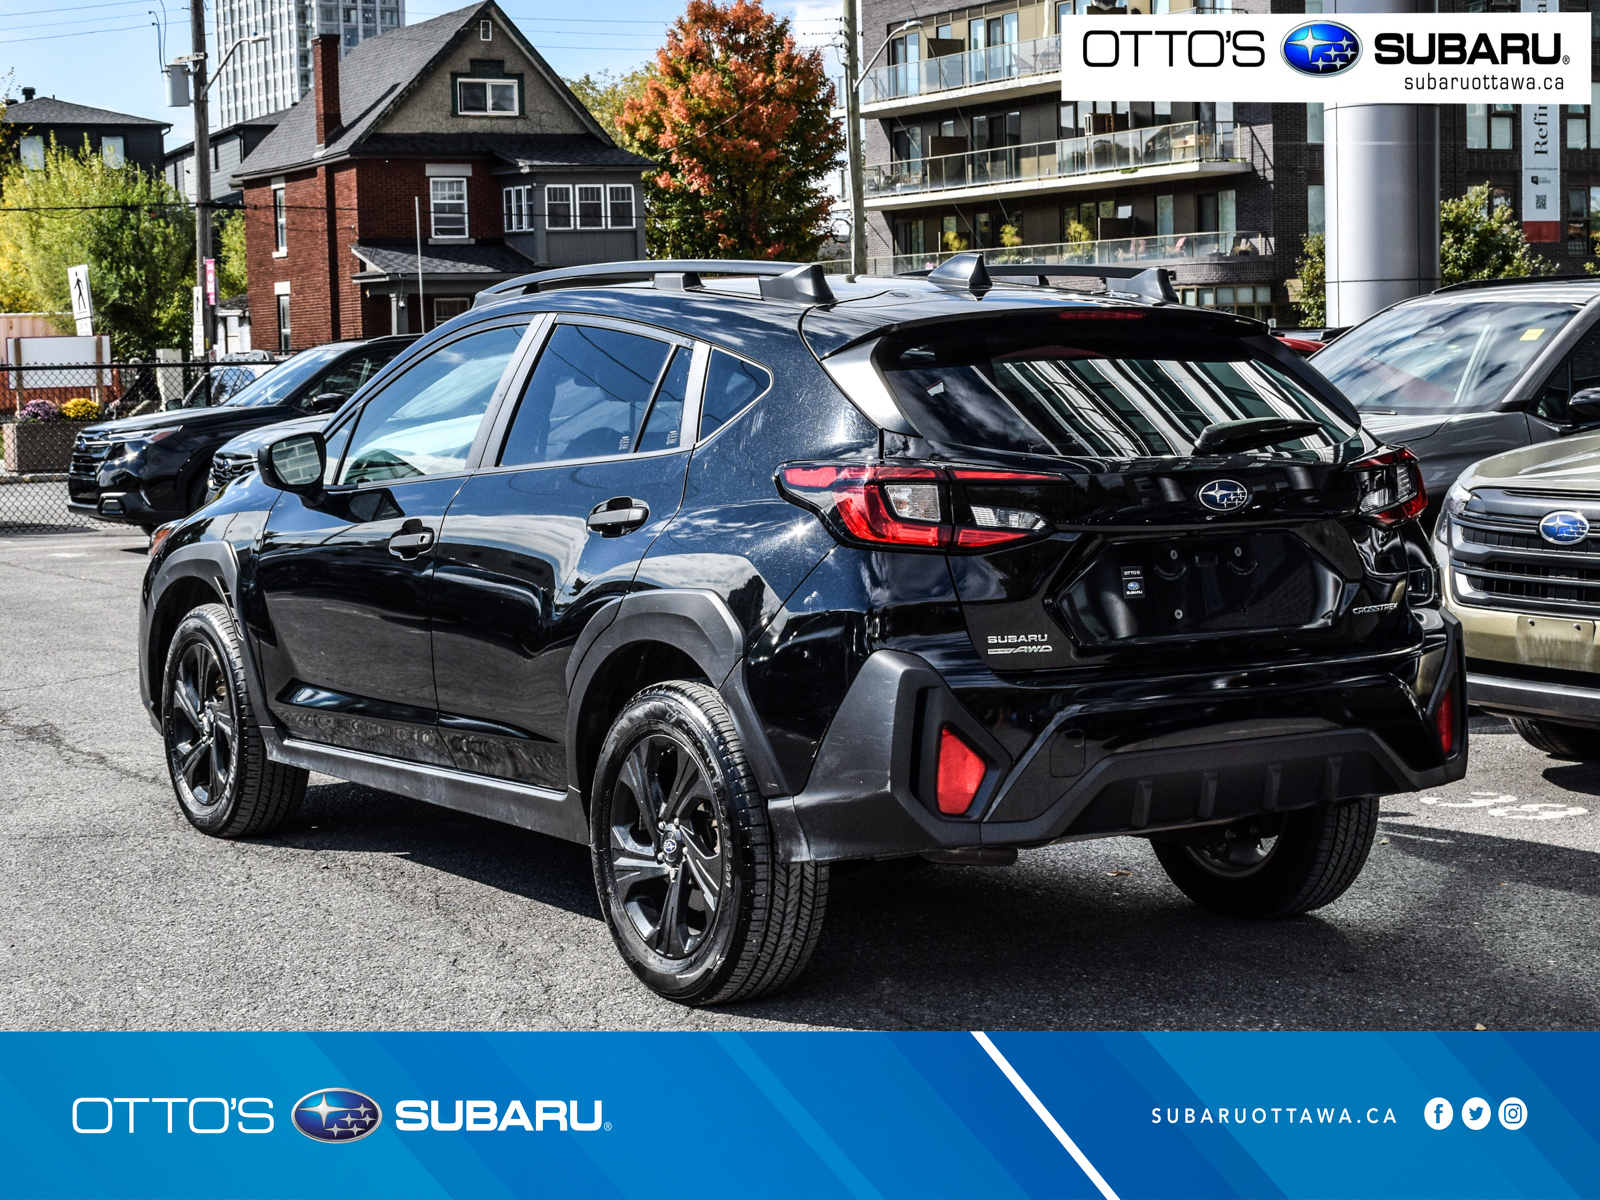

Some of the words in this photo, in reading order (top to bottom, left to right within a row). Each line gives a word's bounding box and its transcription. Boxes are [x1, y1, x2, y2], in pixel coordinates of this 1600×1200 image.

[1352, 602, 1398, 615] CROSSTREK
[987, 633, 1048, 644] SUBARU
[1012, 644, 1053, 654] AWD
